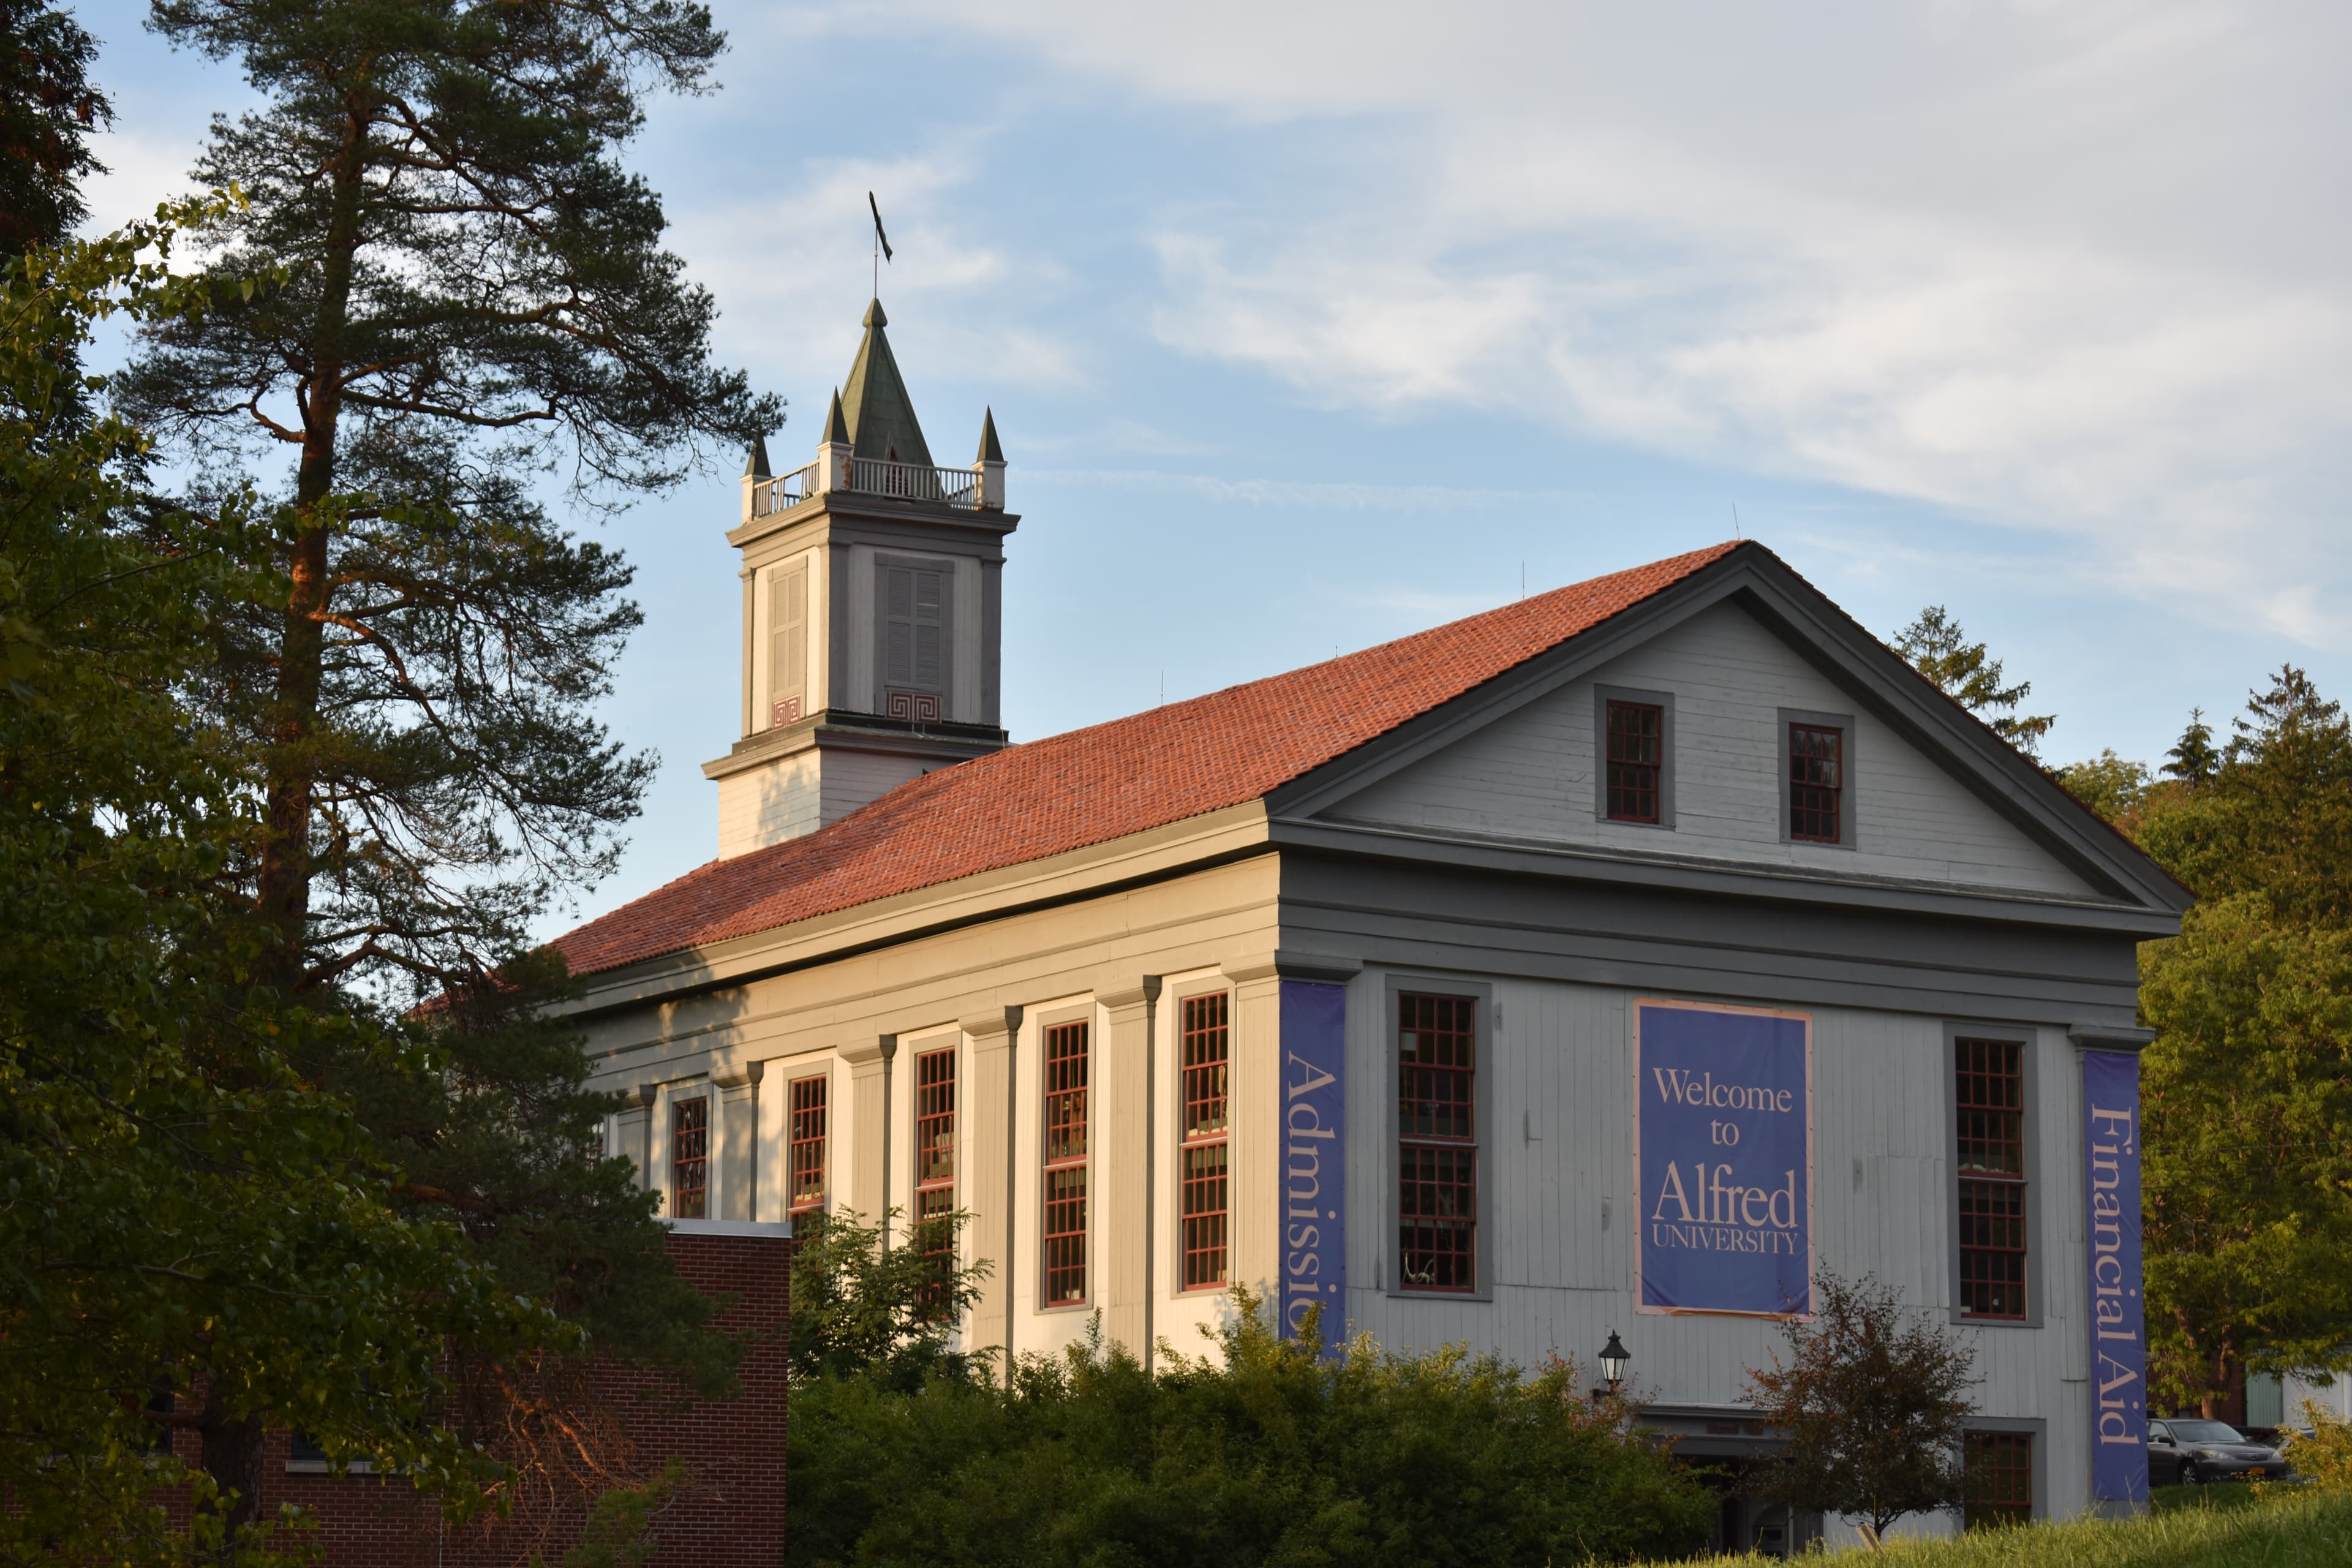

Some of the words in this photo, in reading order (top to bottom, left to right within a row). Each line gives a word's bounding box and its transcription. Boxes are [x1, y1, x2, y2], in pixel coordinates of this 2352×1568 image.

[1653, 1067, 1793, 1113] Welcome
[1711, 1118, 1740, 1146] to
[1287, 1049, 1337, 1363] Admissio
[1651, 1159, 1798, 1229] Alfred
[2092, 1103, 2137, 1342] Financial
[1652, 1223, 1799, 1255] UNIVERSITY
[2098, 1349, 2140, 1446] Aid
